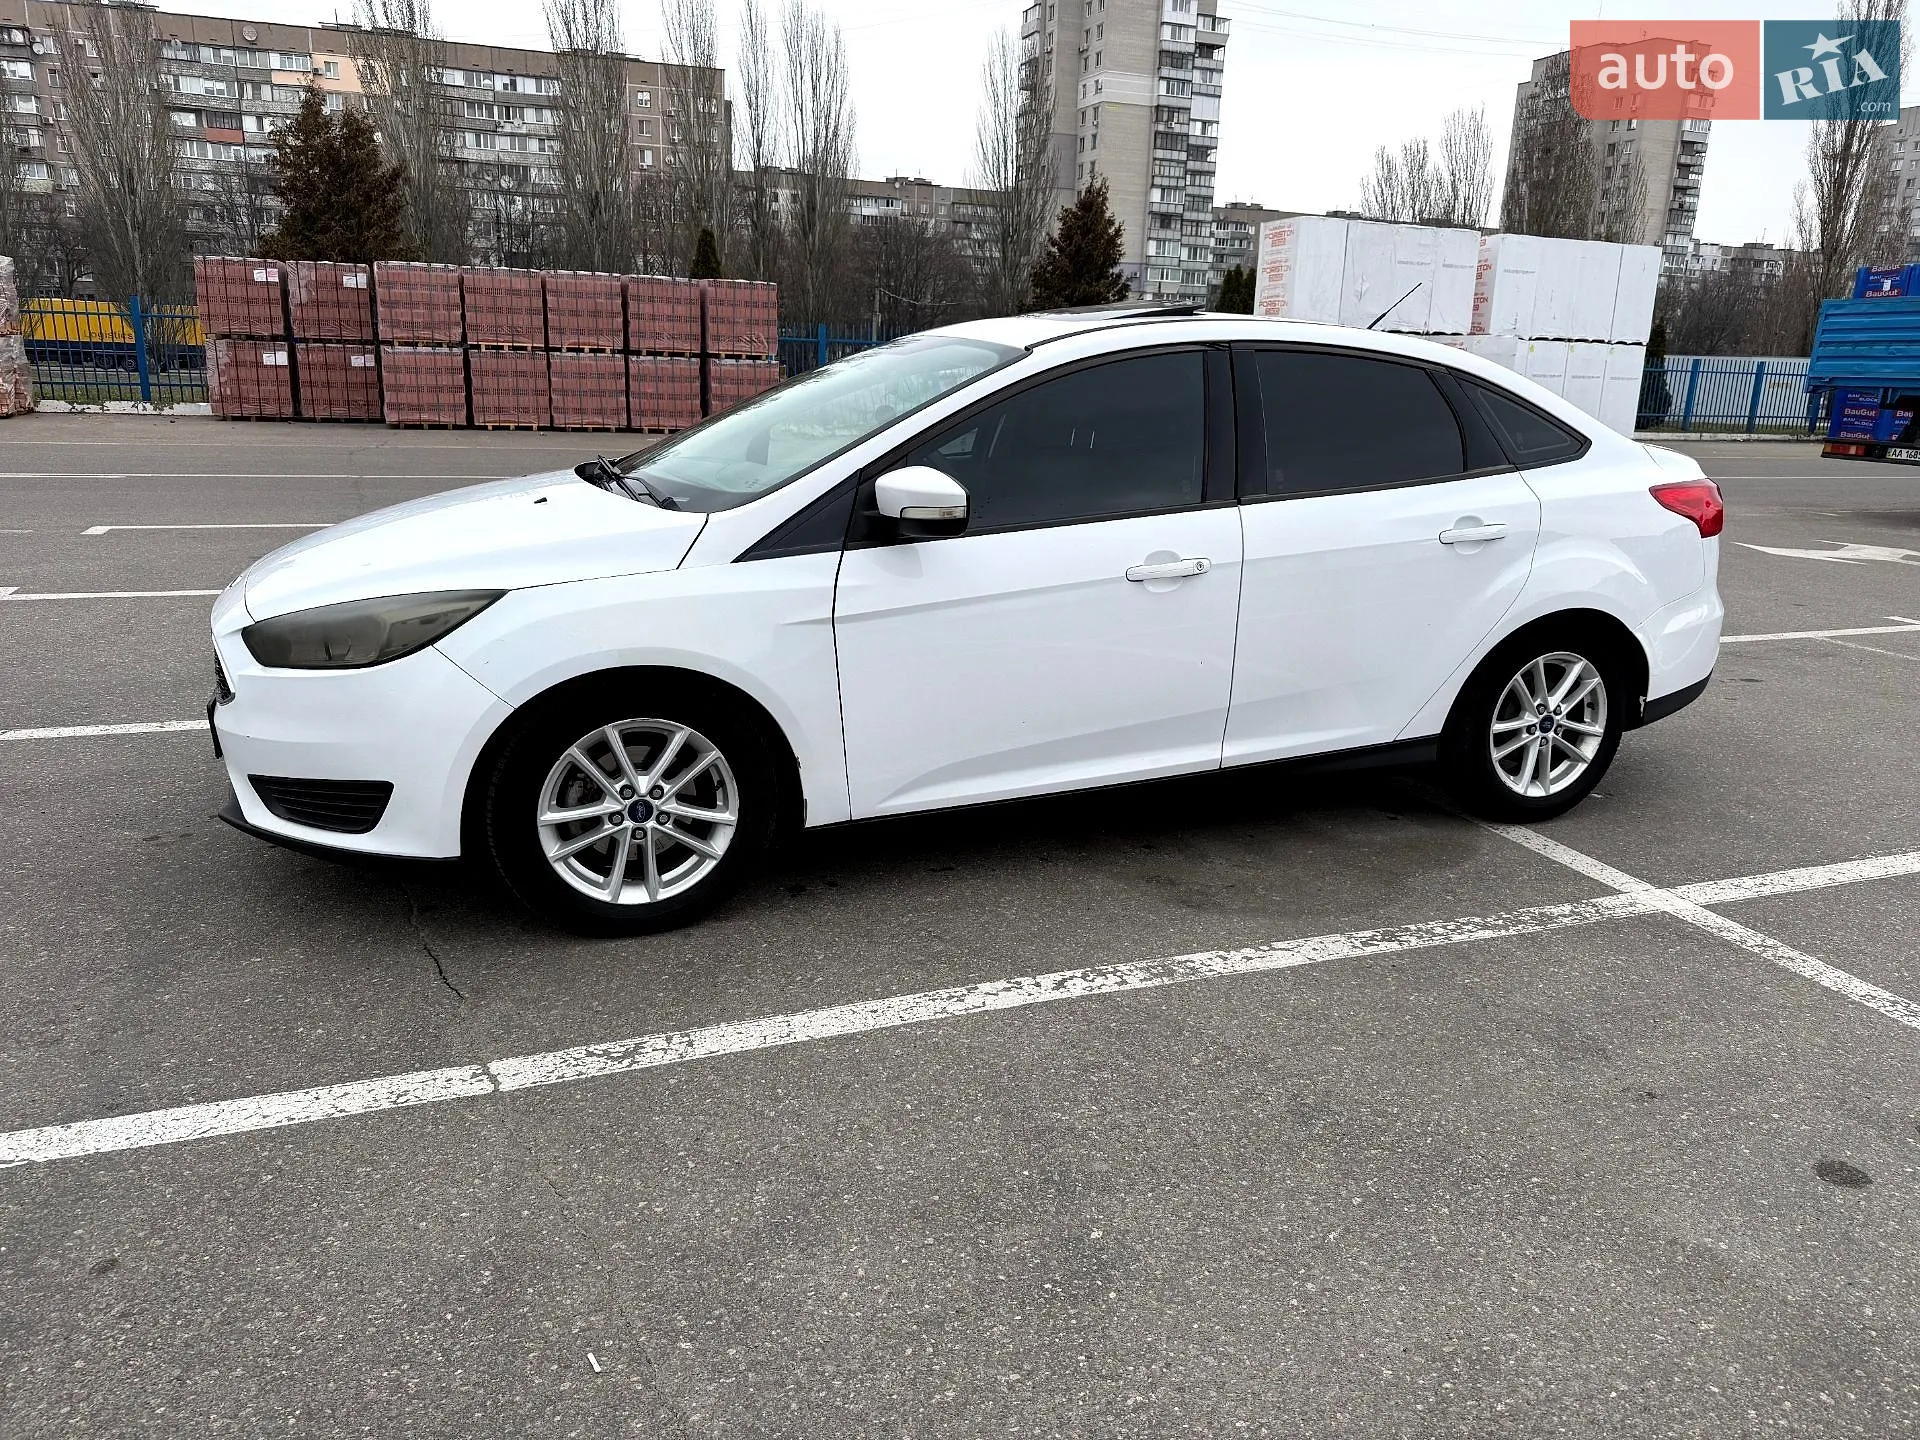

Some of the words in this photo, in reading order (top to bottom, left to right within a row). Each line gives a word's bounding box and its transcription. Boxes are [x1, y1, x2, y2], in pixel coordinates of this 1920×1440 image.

[1865, 289, 1899, 298] BauGut
[1844, 408, 1875, 417] BauGut
[1840, 431, 1870, 440] BauGut
[1892, 448, 1903, 458] AA
